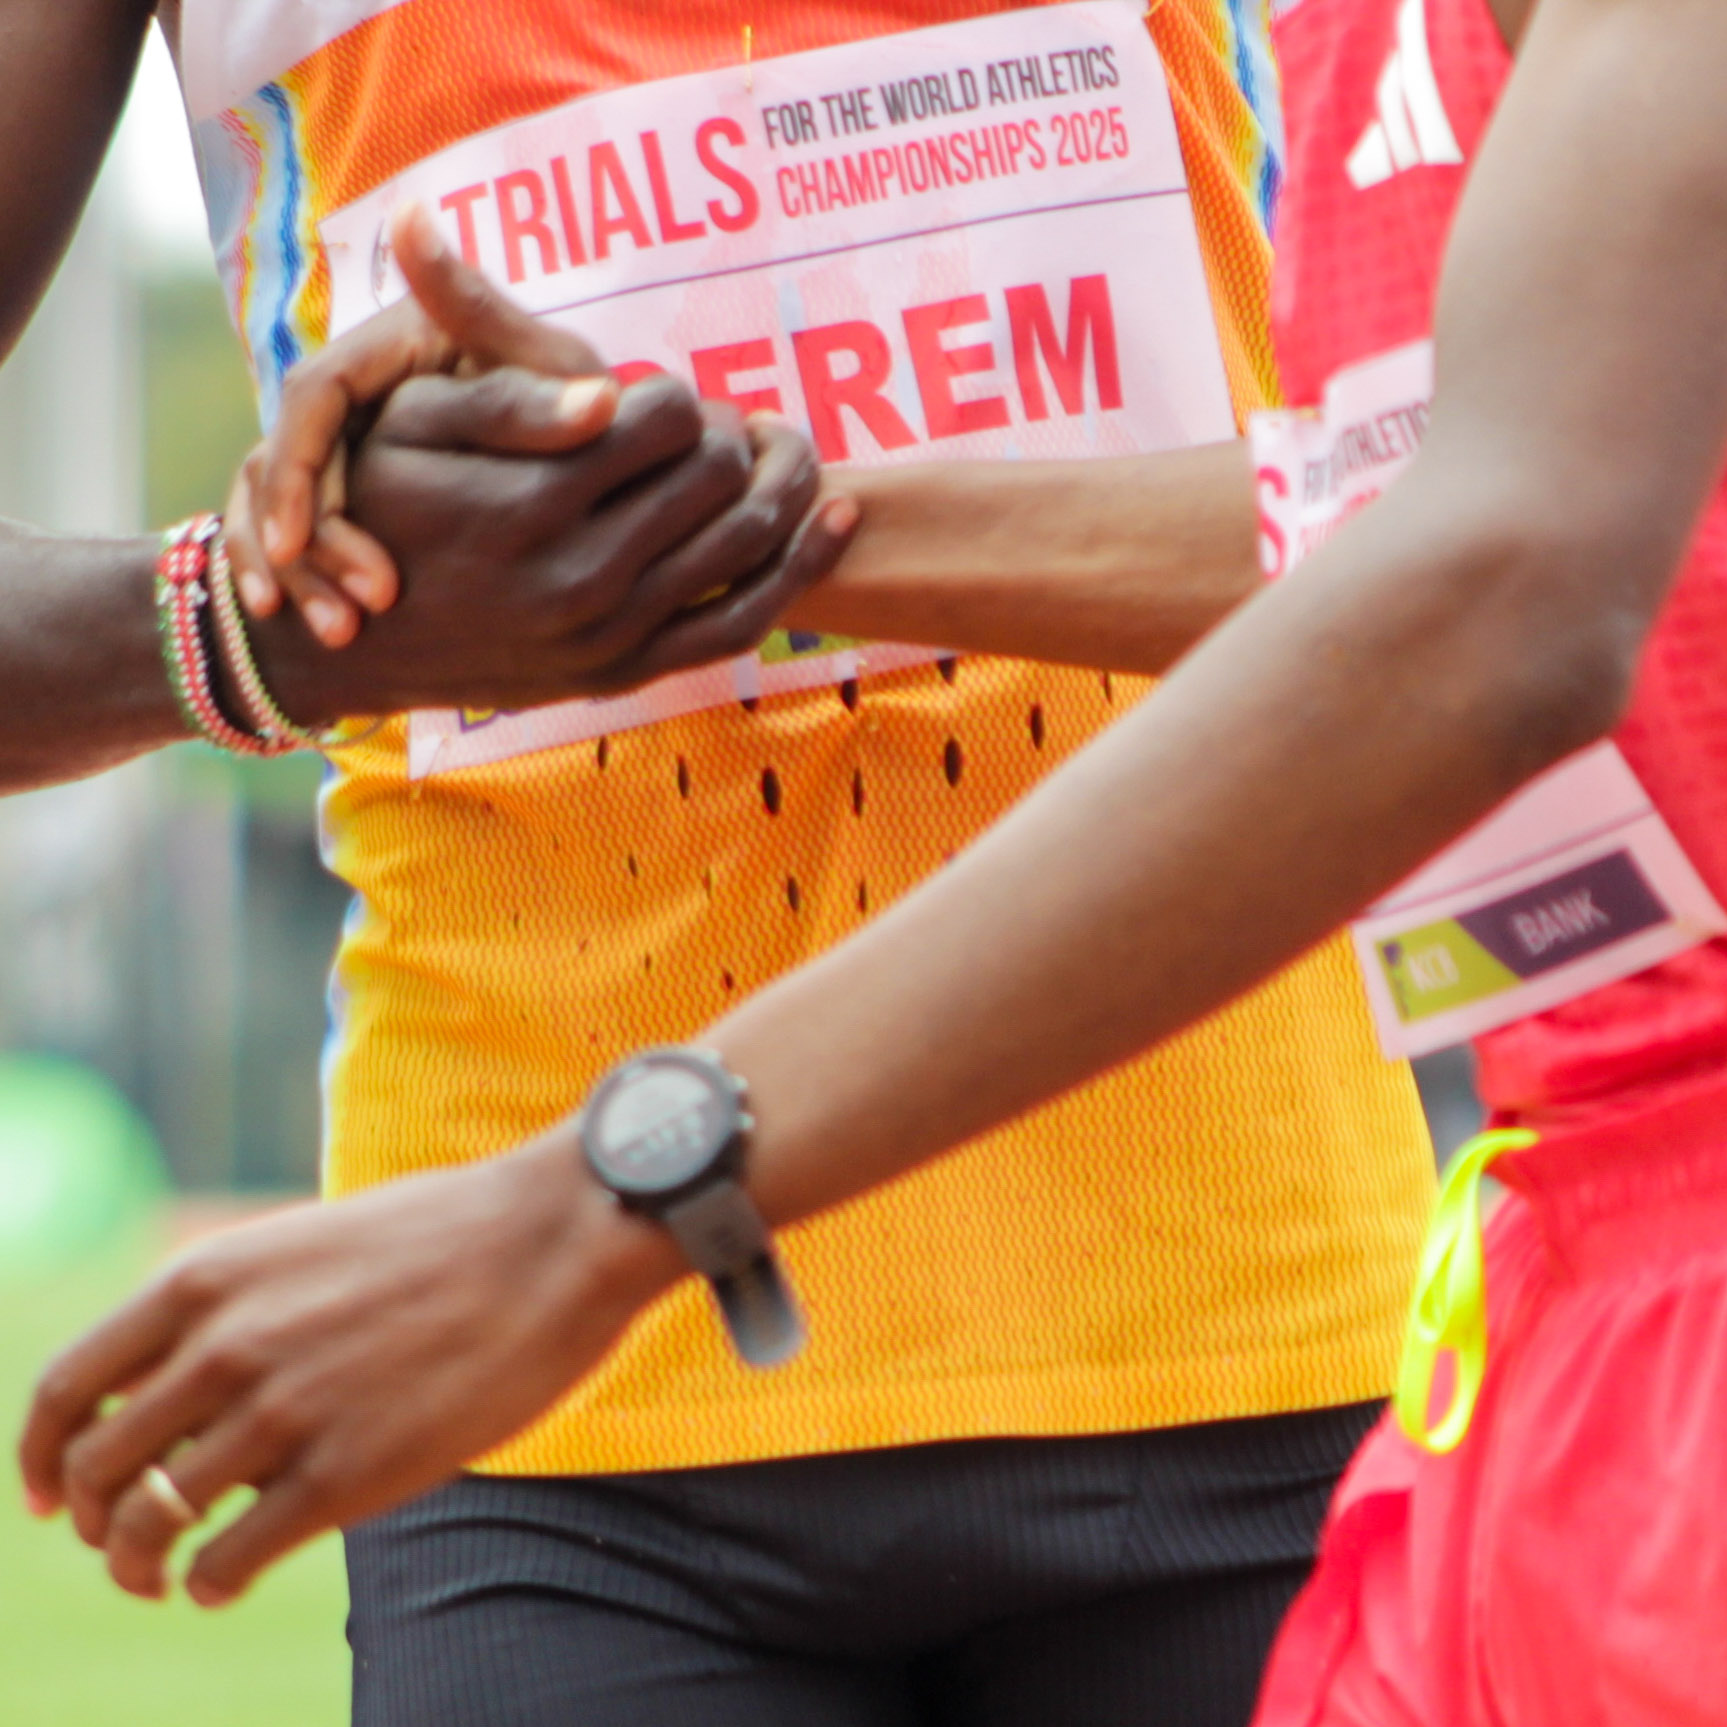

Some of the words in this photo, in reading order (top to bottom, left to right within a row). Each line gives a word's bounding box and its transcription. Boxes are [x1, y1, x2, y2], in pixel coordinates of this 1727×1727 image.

[761, 101, 820, 149] FOR
[820, 87, 879, 138] THE
[880, 68, 981, 125] WORLD
[987, 45, 1121, 105] ATHLETICS
[440, 117, 761, 284] TRIALS
[776, 118, 1047, 219] CHAMPIONSHIPS
[1049, 106, 1131, 168] 2025
[607, 272, 1124, 465] EREM
[1511, 889, 1611, 956] BANK
